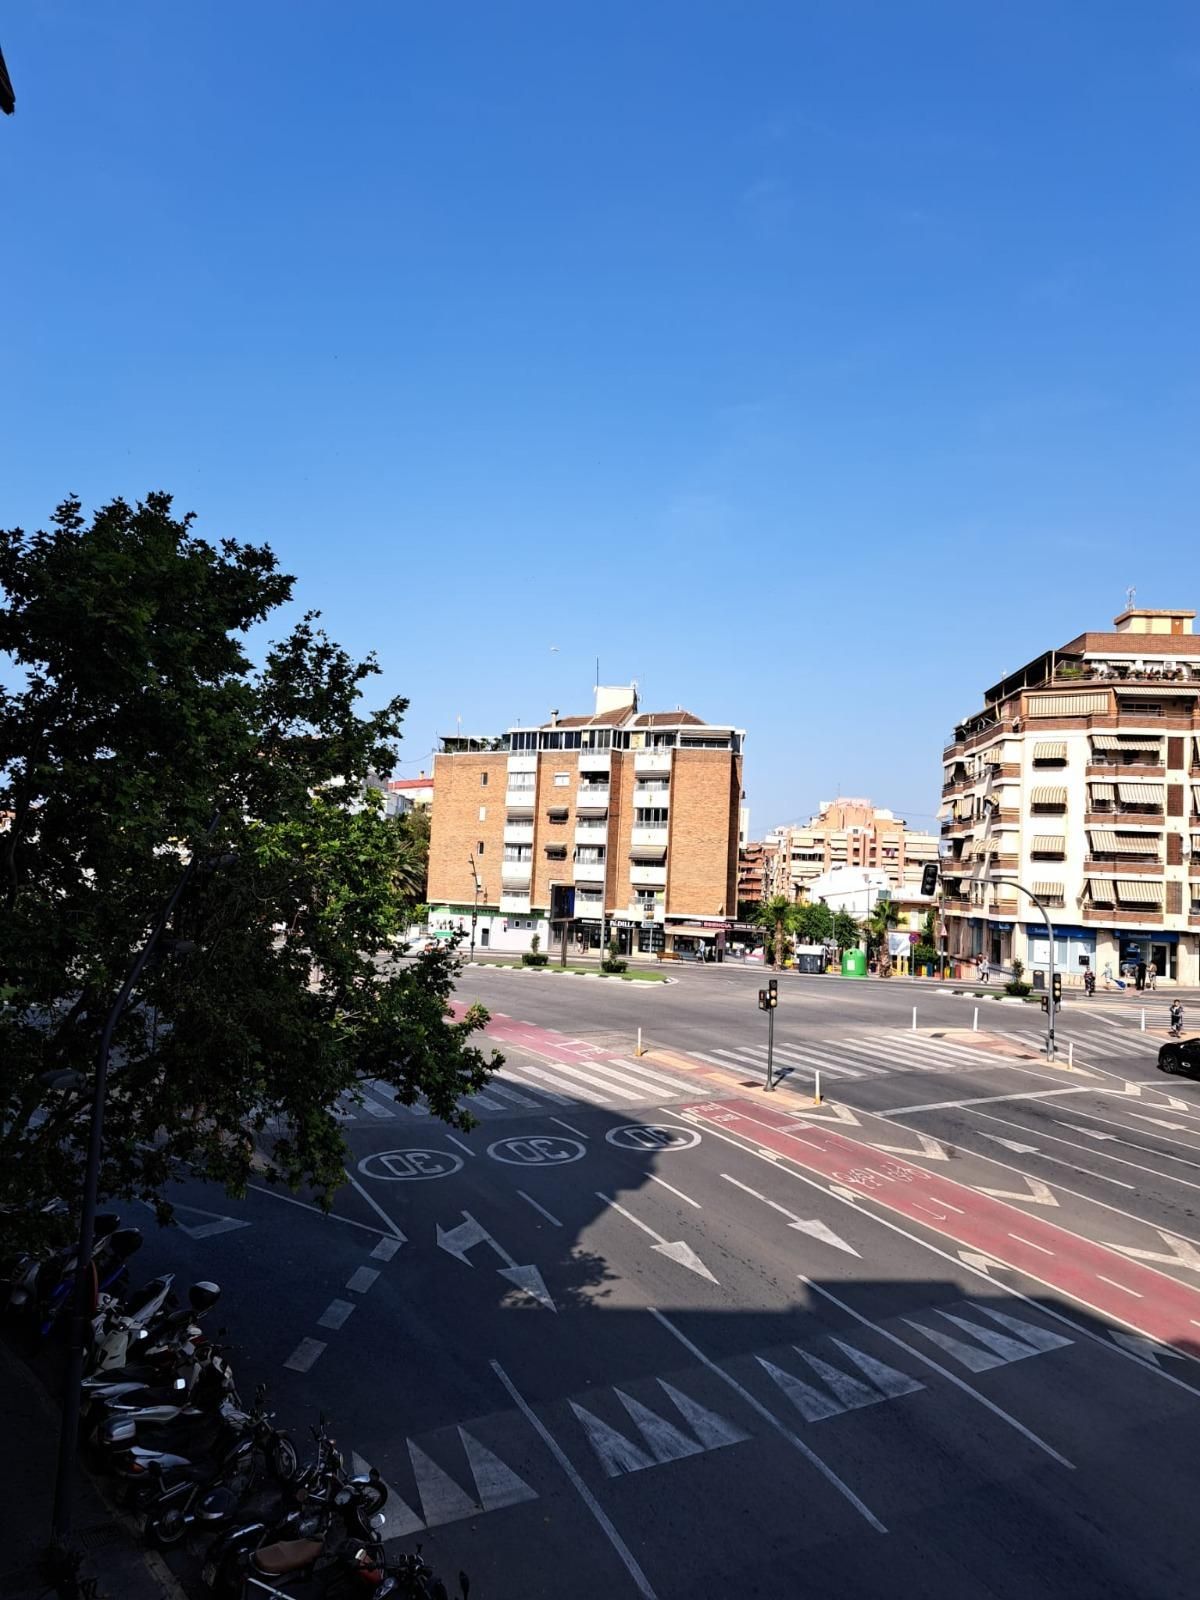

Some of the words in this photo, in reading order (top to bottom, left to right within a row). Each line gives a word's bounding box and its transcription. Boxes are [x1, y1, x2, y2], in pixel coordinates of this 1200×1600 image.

[623, 1126, 688, 1148] 30
[504, 1139, 570, 1162] 30
[379, 1152, 445, 1176] 30
